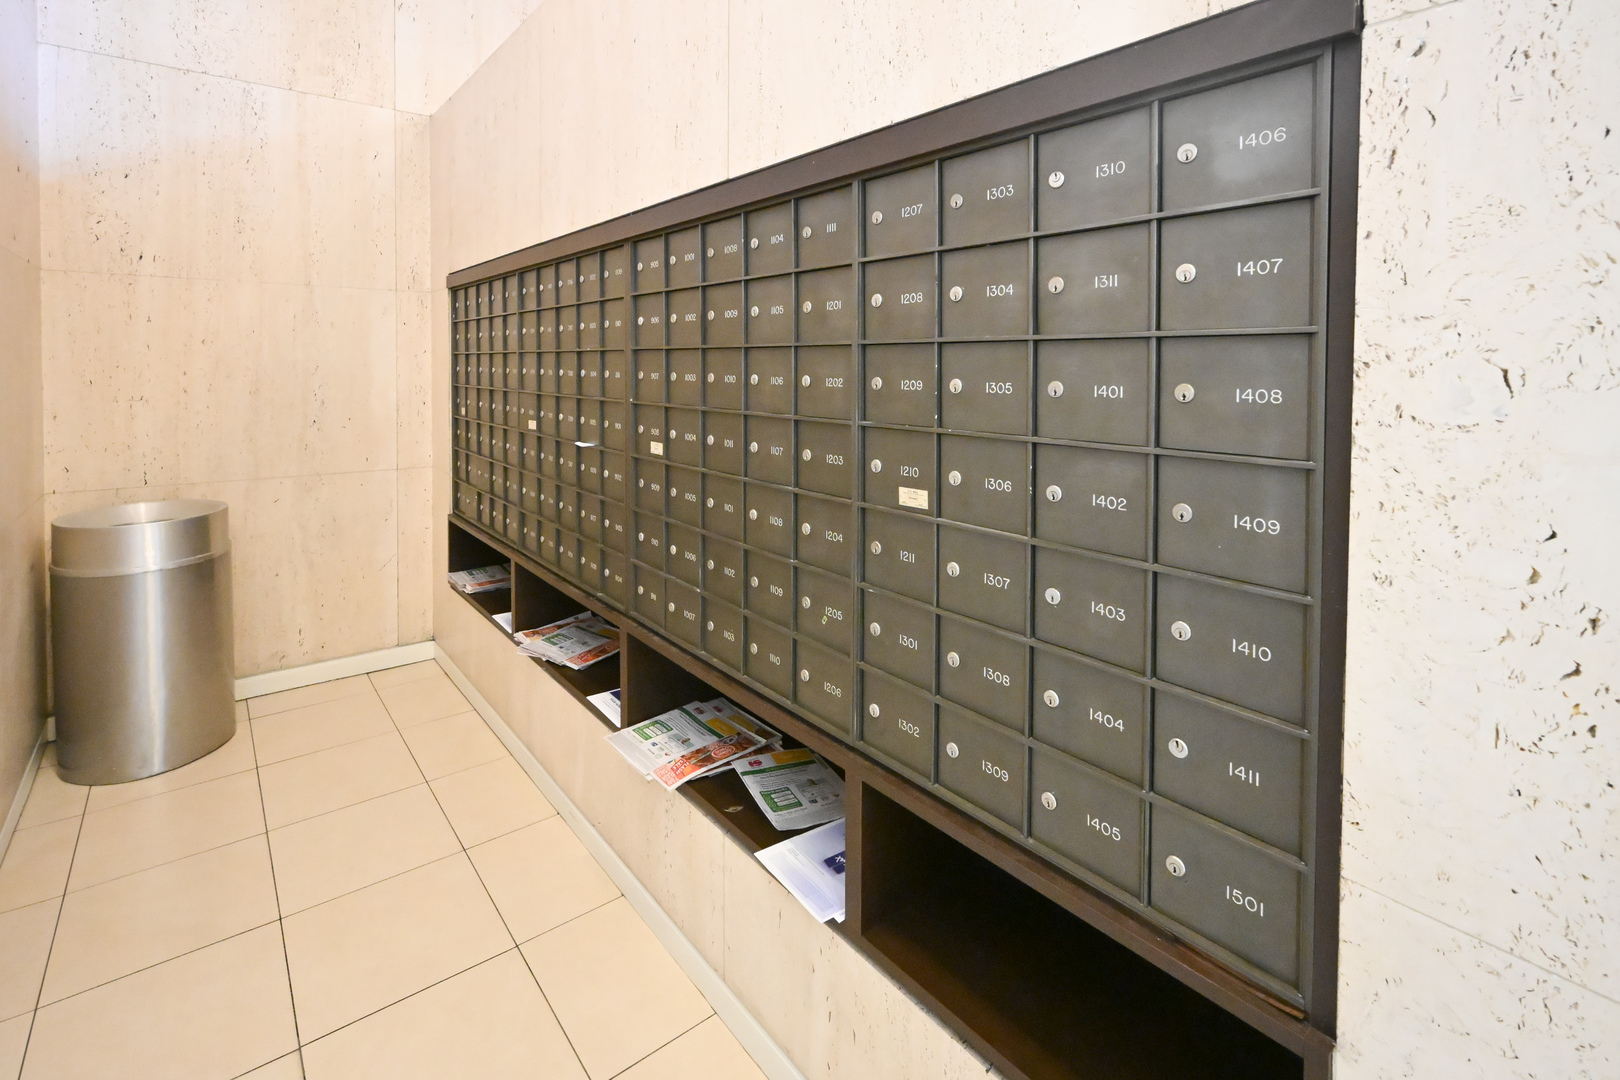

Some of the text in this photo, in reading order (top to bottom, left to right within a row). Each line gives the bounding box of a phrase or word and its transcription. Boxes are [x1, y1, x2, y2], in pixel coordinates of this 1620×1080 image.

[1239, 126, 1287, 150] 1406
[1095, 160, 1126, 179] 1310
[986, 184, 1014, 201] 1303
[901, 203, 924, 218] 1207
[826, 222, 837, 234] 1111
[770, 233, 784, 245] 1104
[724, 243, 738, 255] 1008
[684, 252, 695, 262] 1001
[1237, 257, 1284, 277] 1407
[1094, 274, 1118, 289] 1311
[986, 283, 1014, 298] 1304
[826, 300, 842, 311] 1201
[900, 292, 924, 305] 1208
[724, 309, 739, 319] 1009
[770, 304, 785, 315] 1105
[684, 313, 697, 322] 1002
[684, 373, 697, 382] 1003
[724, 374, 737, 384] 1010
[770, 376, 784, 386] 1106
[825, 377, 844, 388] 1202
[900, 379, 923, 391] 1209
[985, 381, 1013, 395] 1305
[1093, 385, 1124, 399] 1401
[1235, 388, 1283, 404] 1408
[684, 432, 697, 442] 1004
[723, 438, 734, 448] 1011
[770, 445, 784, 456] 1107
[826, 453, 844, 466] 1203
[900, 465, 920, 478] 1210
[985, 477, 1012, 493] 1306
[684, 492, 697, 503] 1005
[1092, 493, 1127, 512] 1402
[723, 503, 734, 513] 1101
[769, 515, 784, 527] 1108
[1233, 514, 1281, 535] 1409
[825, 530, 843, 543] 1204
[684, 550, 697, 562] 1006
[900, 549, 915, 564] 1211
[723, 566, 736, 578] 1102
[983, 572, 1011, 590] 1307
[770, 584, 784, 597] 1109
[824, 606, 843, 621] 1205
[1091, 600, 1126, 622] 1403
[723, 629, 735, 642] 1103
[899, 634, 918, 651] 1301
[1232, 638, 1272, 662] 1410
[769, 652, 781, 666] 1110
[983, 666, 1010, 687] 1308
[823, 681, 842, 698] 1206
[1089, 707, 1125, 733] 1404
[898, 718, 920, 738] 1302
[982, 759, 1009, 782] 1309
[1228, 761, 1260, 787] 1411
[1087, 813, 1121, 841] 1405
[1226, 885, 1264, 917] 1501
